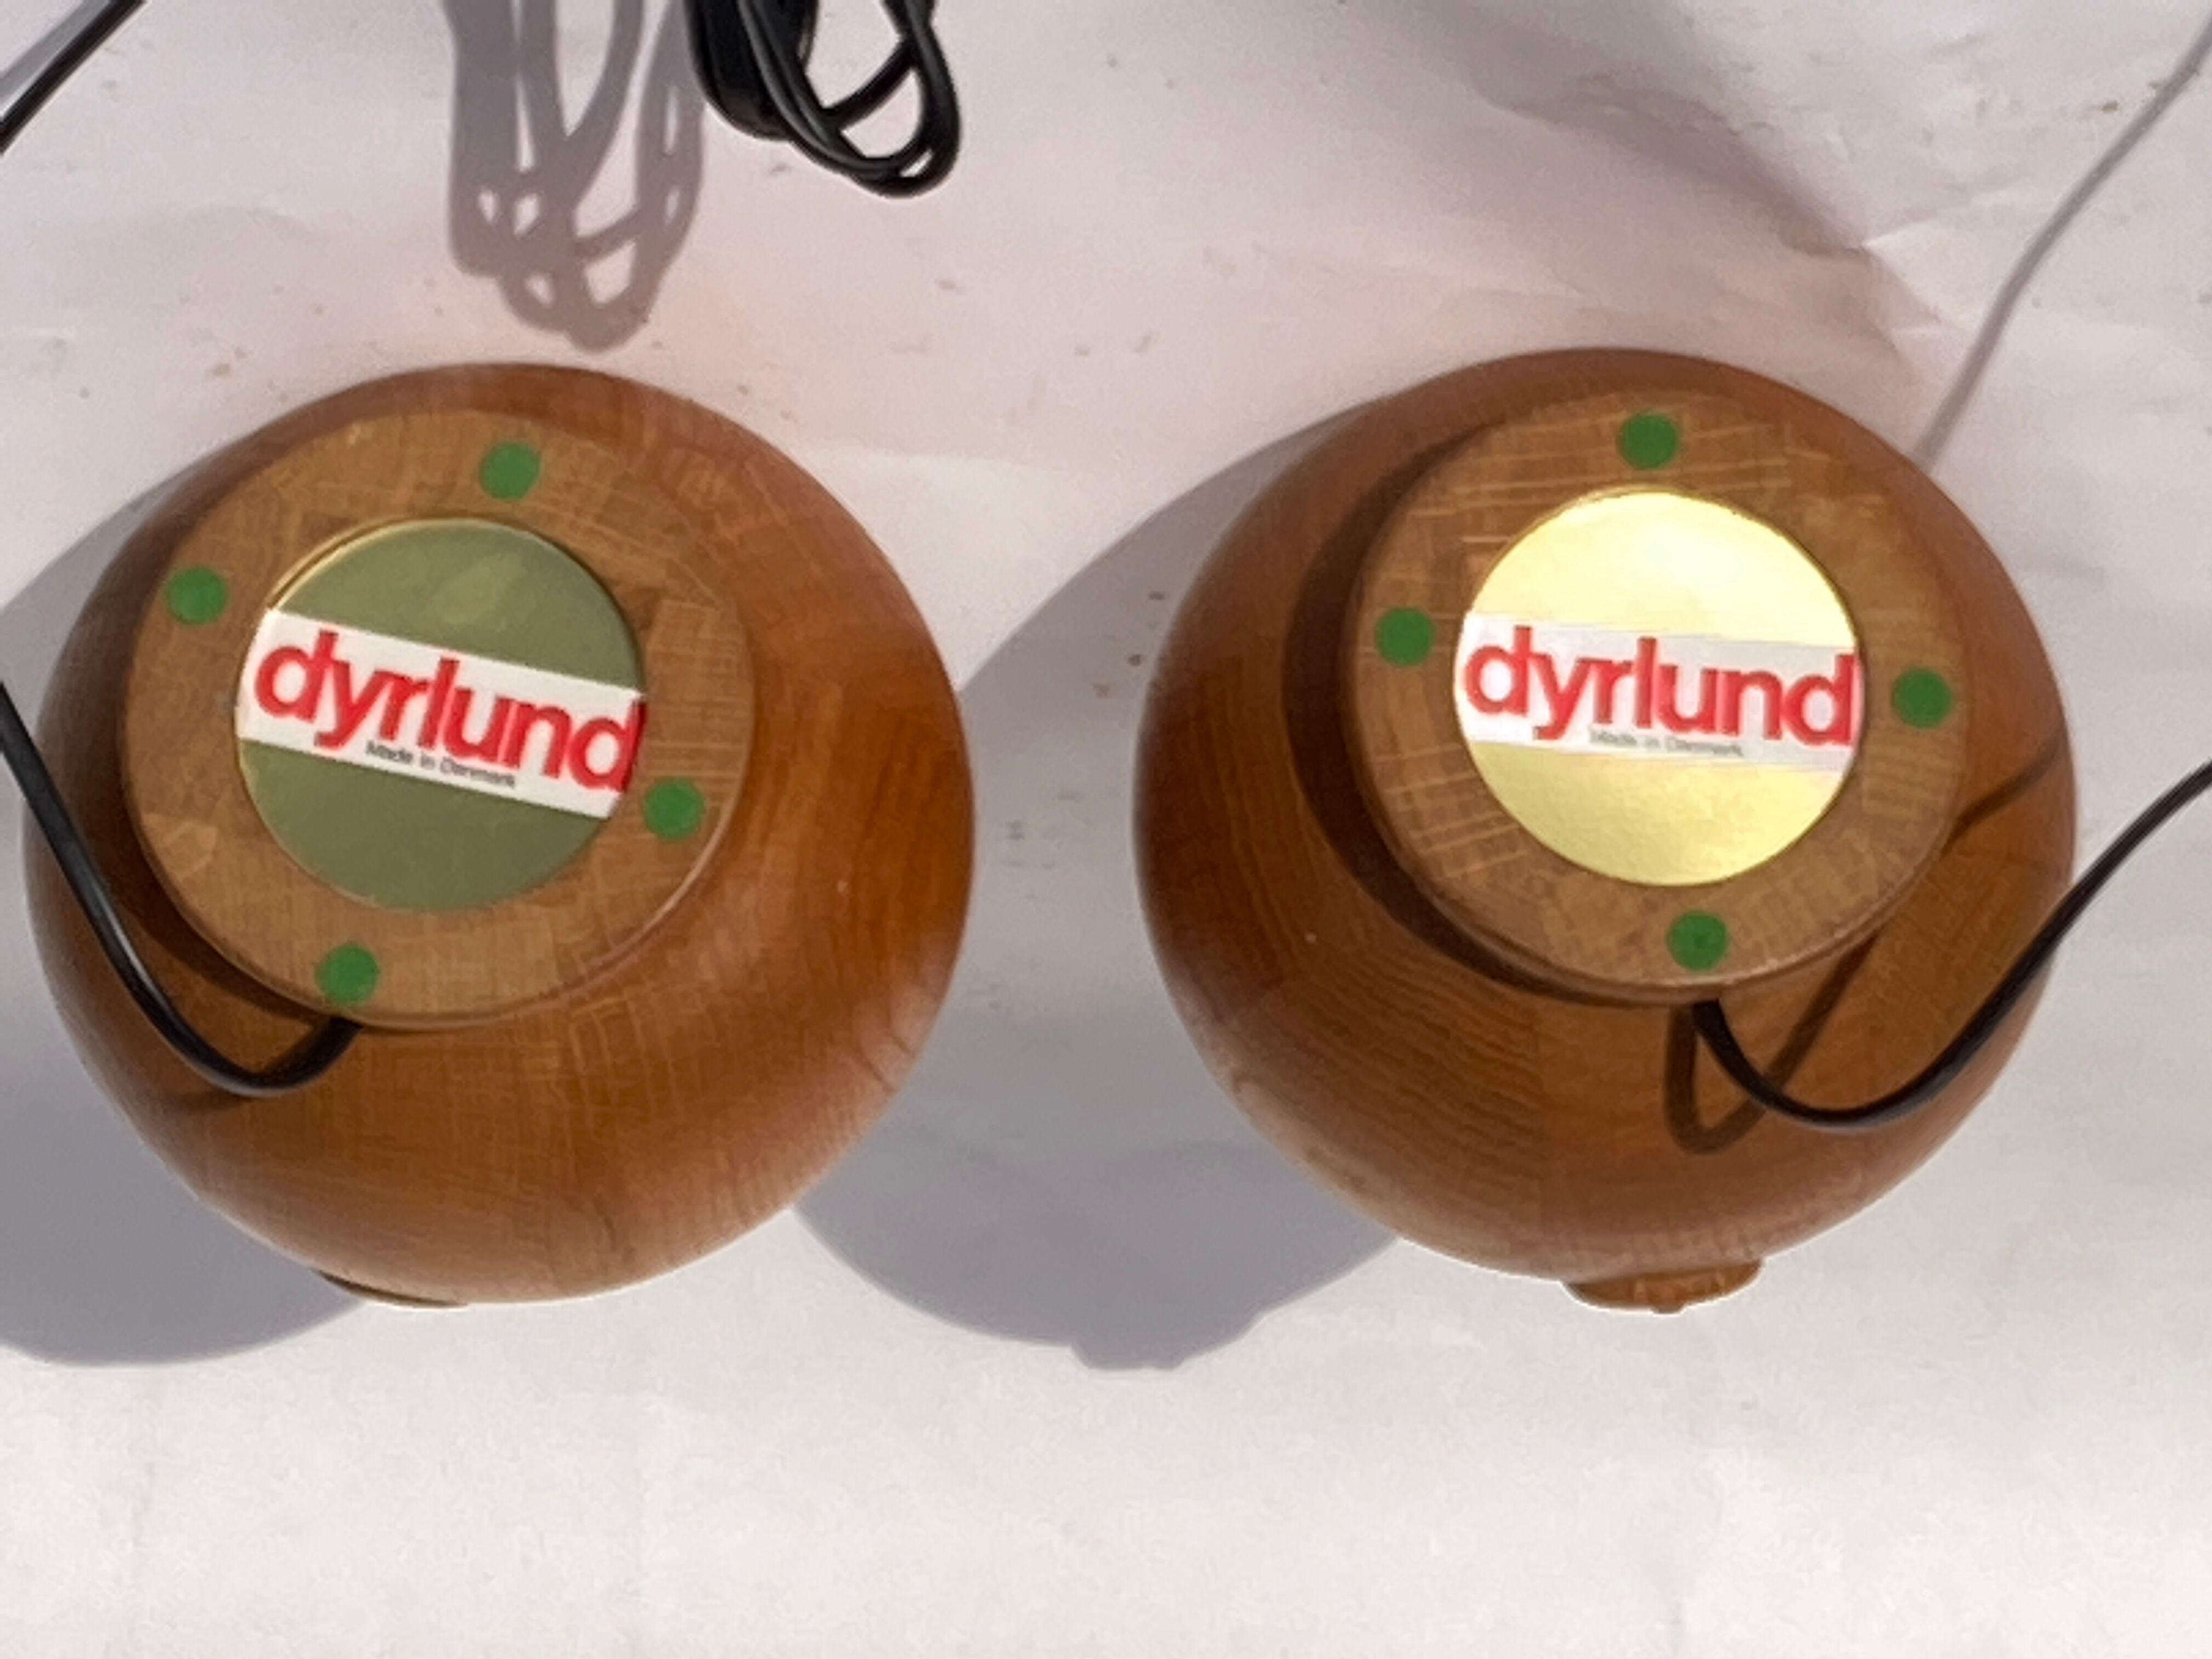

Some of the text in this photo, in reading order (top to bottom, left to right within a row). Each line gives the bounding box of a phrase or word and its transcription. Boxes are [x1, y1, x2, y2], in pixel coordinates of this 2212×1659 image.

[255, 630, 646, 793] dyrlund
[1465, 625, 1857, 746] dyrlund
[366, 740, 515, 788] Made in Denmark
